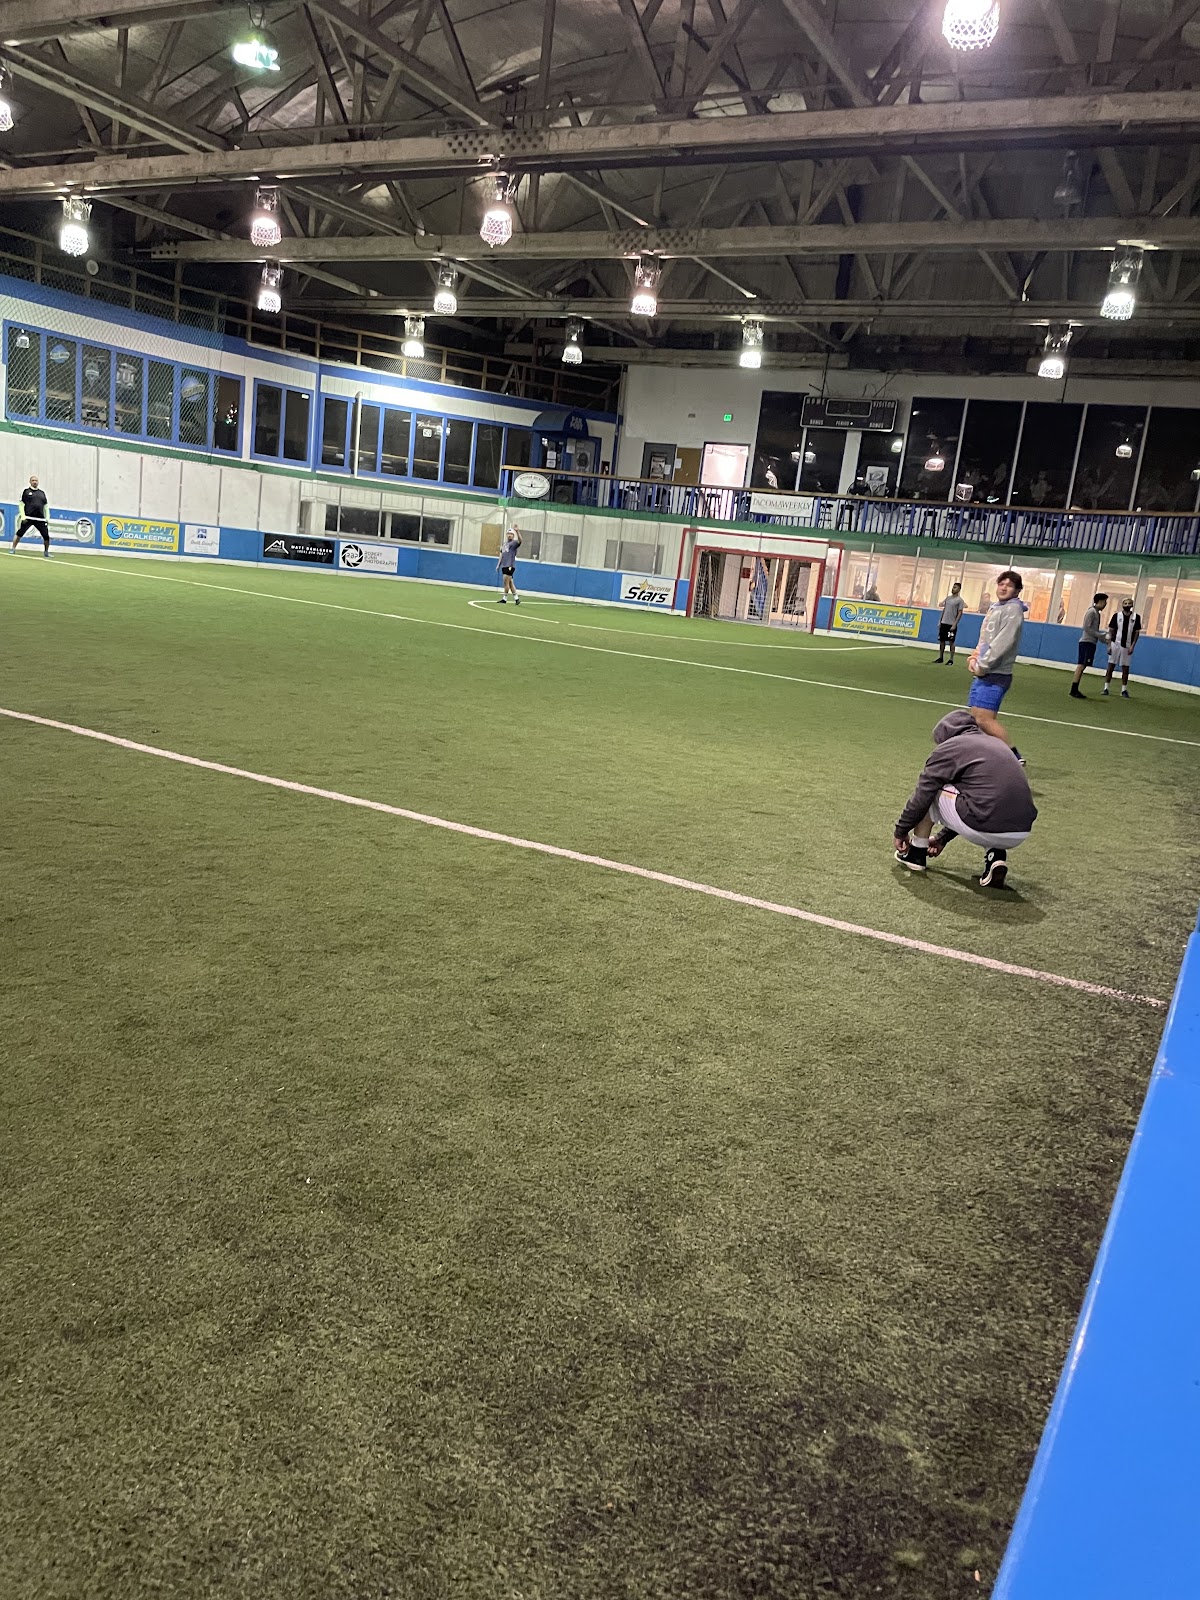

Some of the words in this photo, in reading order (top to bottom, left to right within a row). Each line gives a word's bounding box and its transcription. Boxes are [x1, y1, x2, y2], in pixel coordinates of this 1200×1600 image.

[123, 532, 174, 543] GOALKEEPING
[647, 584, 671, 592] Tacoma
[625, 586, 669, 603] Stars
[856, 616, 913, 628] GOALKEEPING
